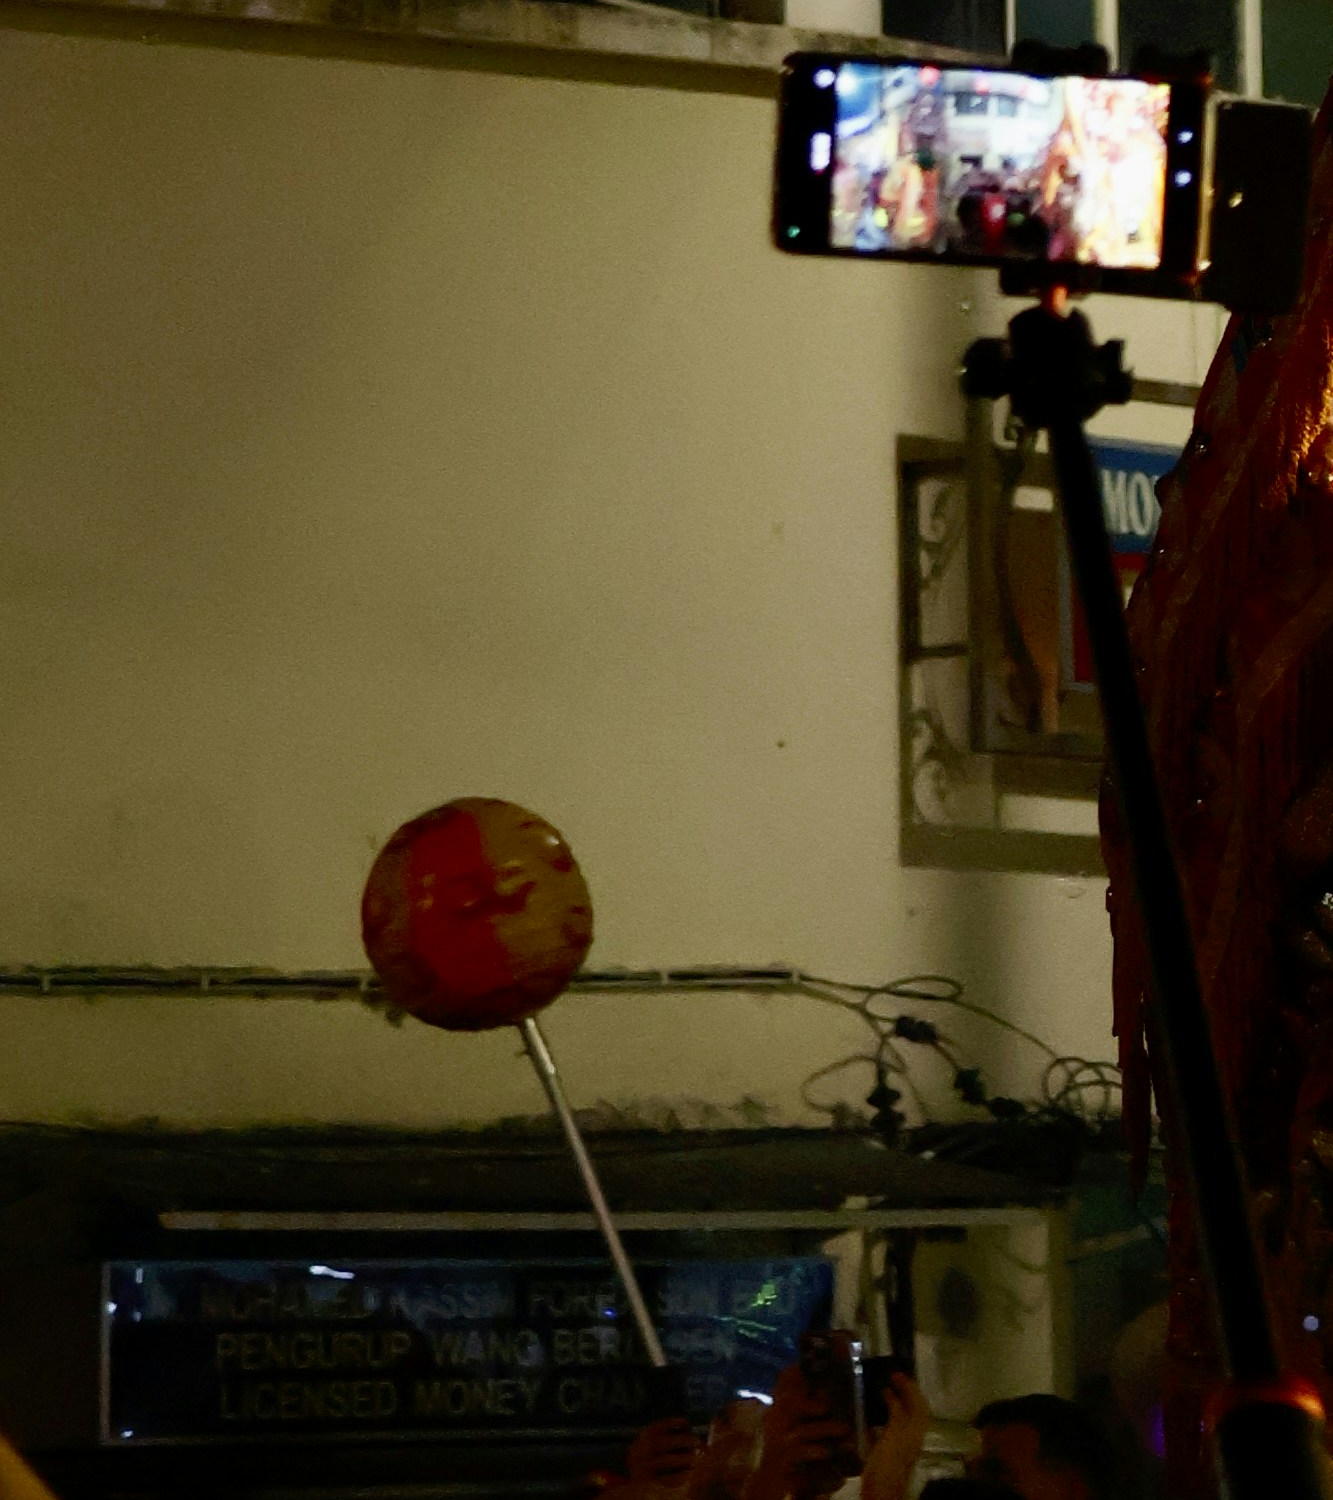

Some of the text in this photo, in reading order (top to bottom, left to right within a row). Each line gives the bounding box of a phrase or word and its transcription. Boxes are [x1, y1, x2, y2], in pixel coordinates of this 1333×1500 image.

[216, 1331, 412, 1371] PENGURUP
[433, 1330, 544, 1368] WANG
[219, 1380, 399, 1420] LICENSED
[414, 1378, 542, 1417] MONEY
